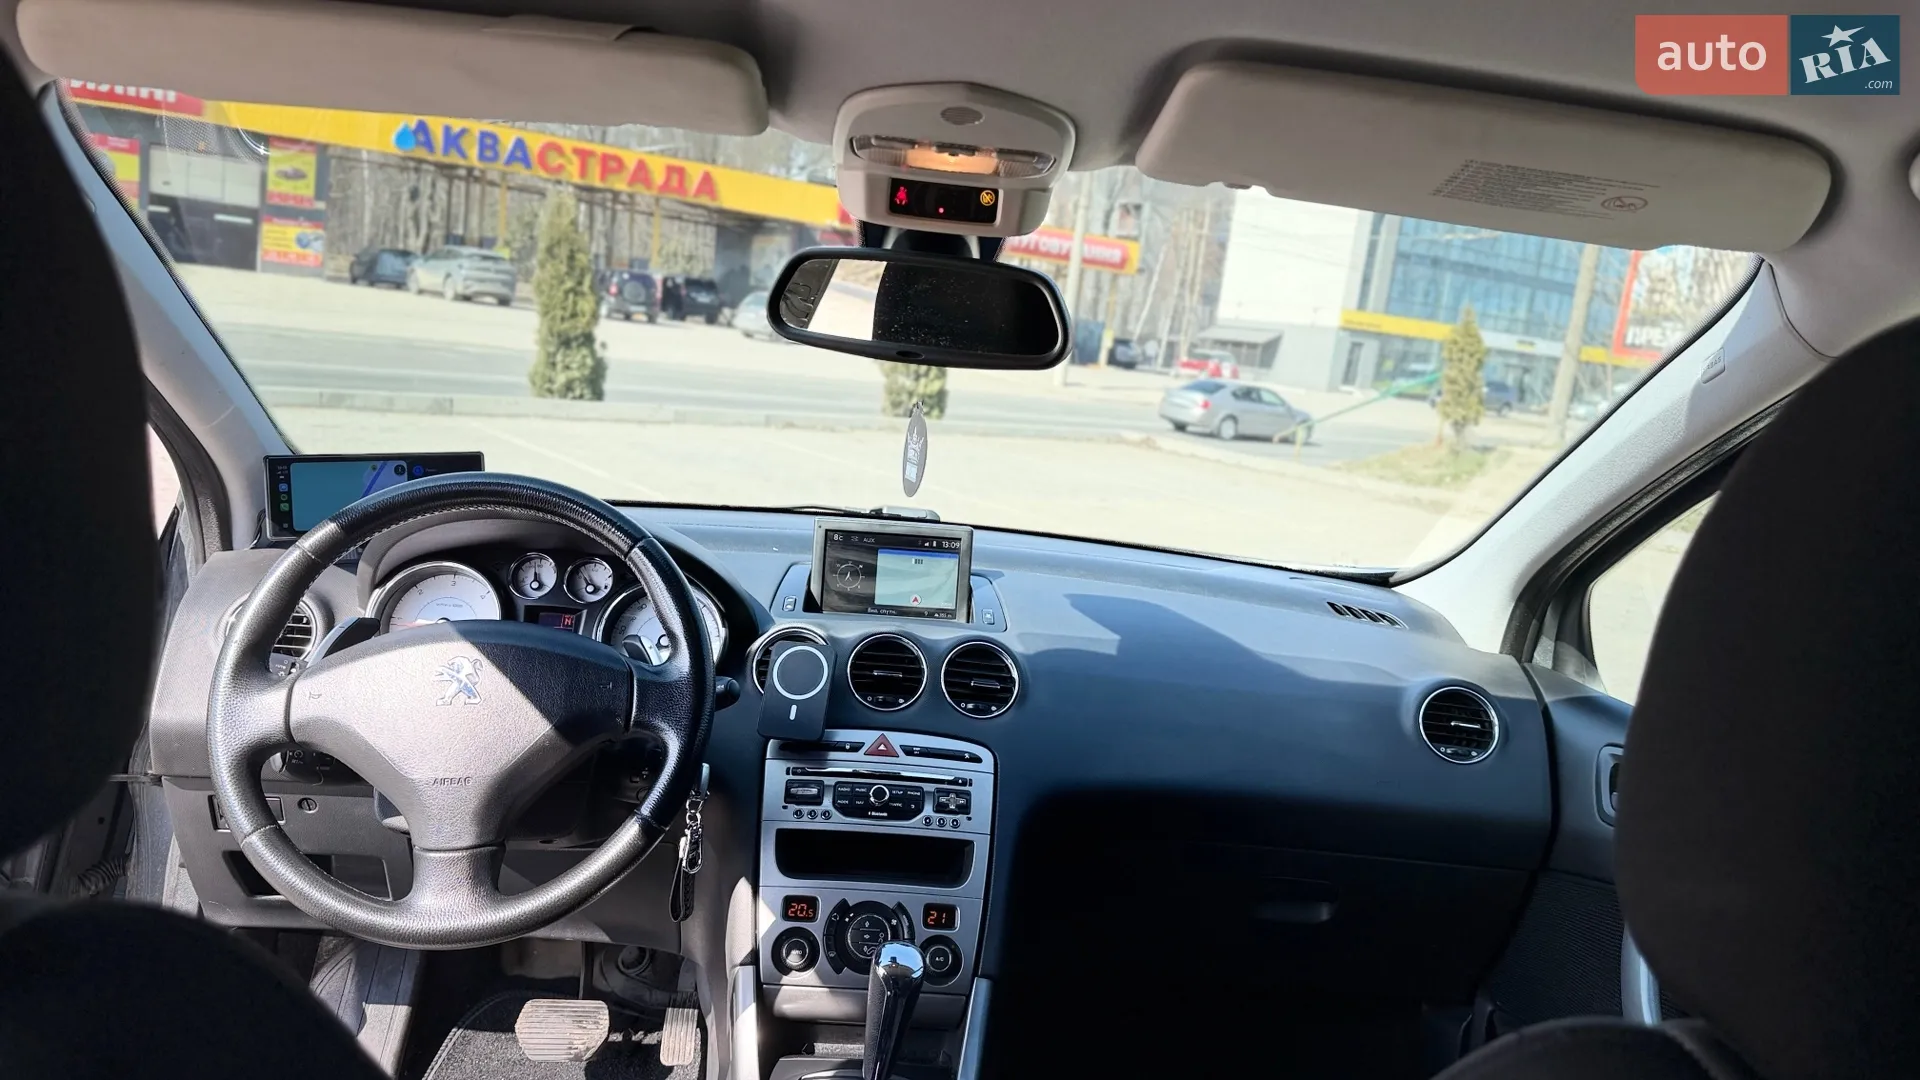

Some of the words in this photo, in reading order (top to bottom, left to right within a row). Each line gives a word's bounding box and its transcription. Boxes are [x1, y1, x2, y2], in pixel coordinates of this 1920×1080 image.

[411, 118, 718, 202] АКВАСТРАДА
[942, 541, 960, 549] 13:09
[433, 776, 473, 787] AIRBAG
[787, 902, 814, 918] 20.5
[927, 910, 946, 925] 21
